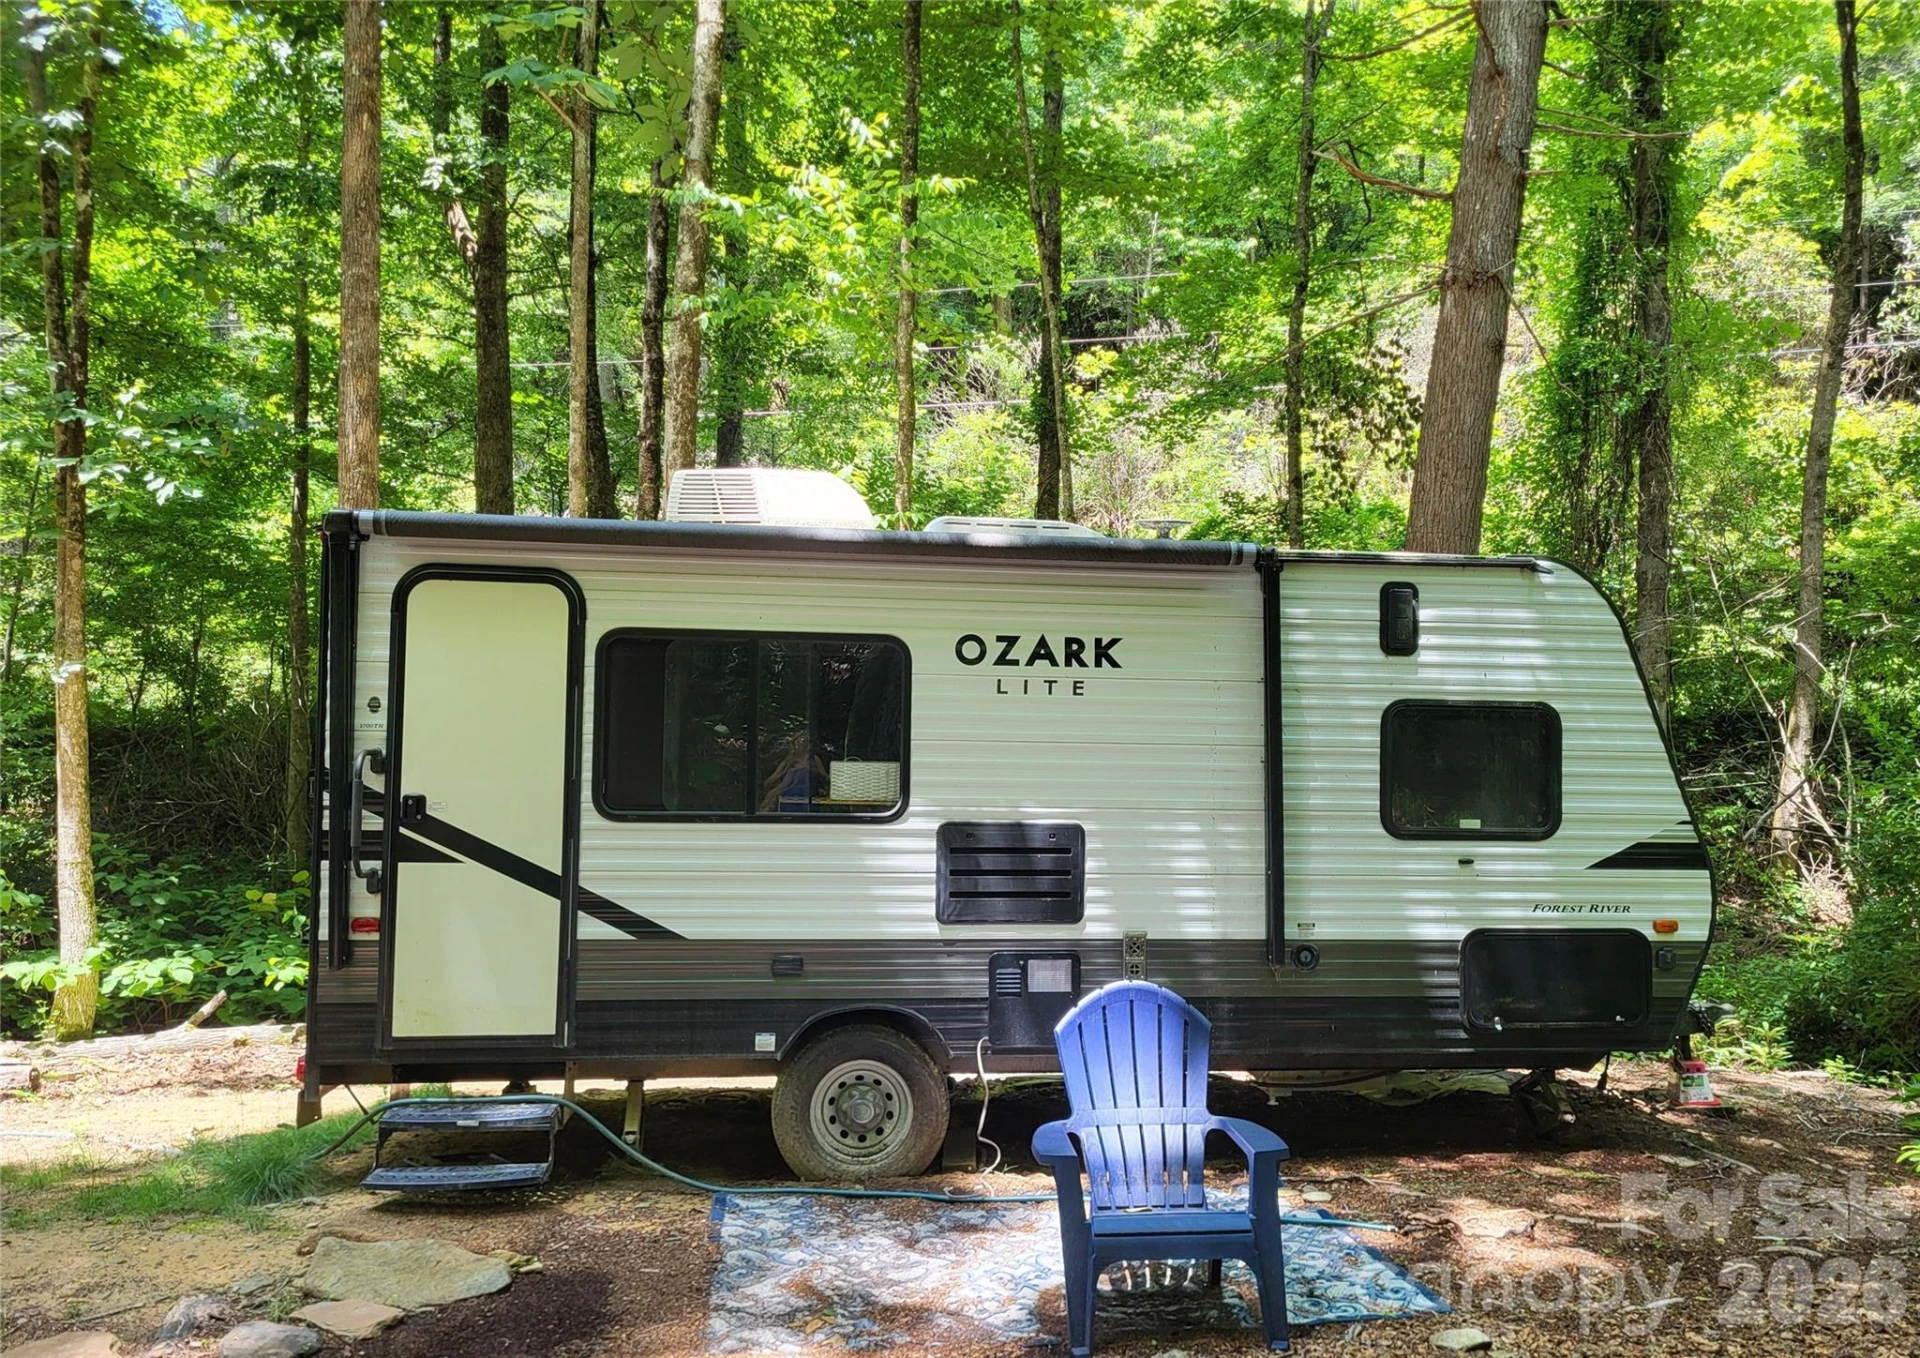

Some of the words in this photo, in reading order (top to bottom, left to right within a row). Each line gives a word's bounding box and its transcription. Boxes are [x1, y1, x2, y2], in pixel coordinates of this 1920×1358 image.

[954, 633, 1124, 669] OZARK
[996, 678, 1085, 697] LITE
[1531, 903, 1586, 913] FOREST
[1588, 903, 1632, 913] RIVER
